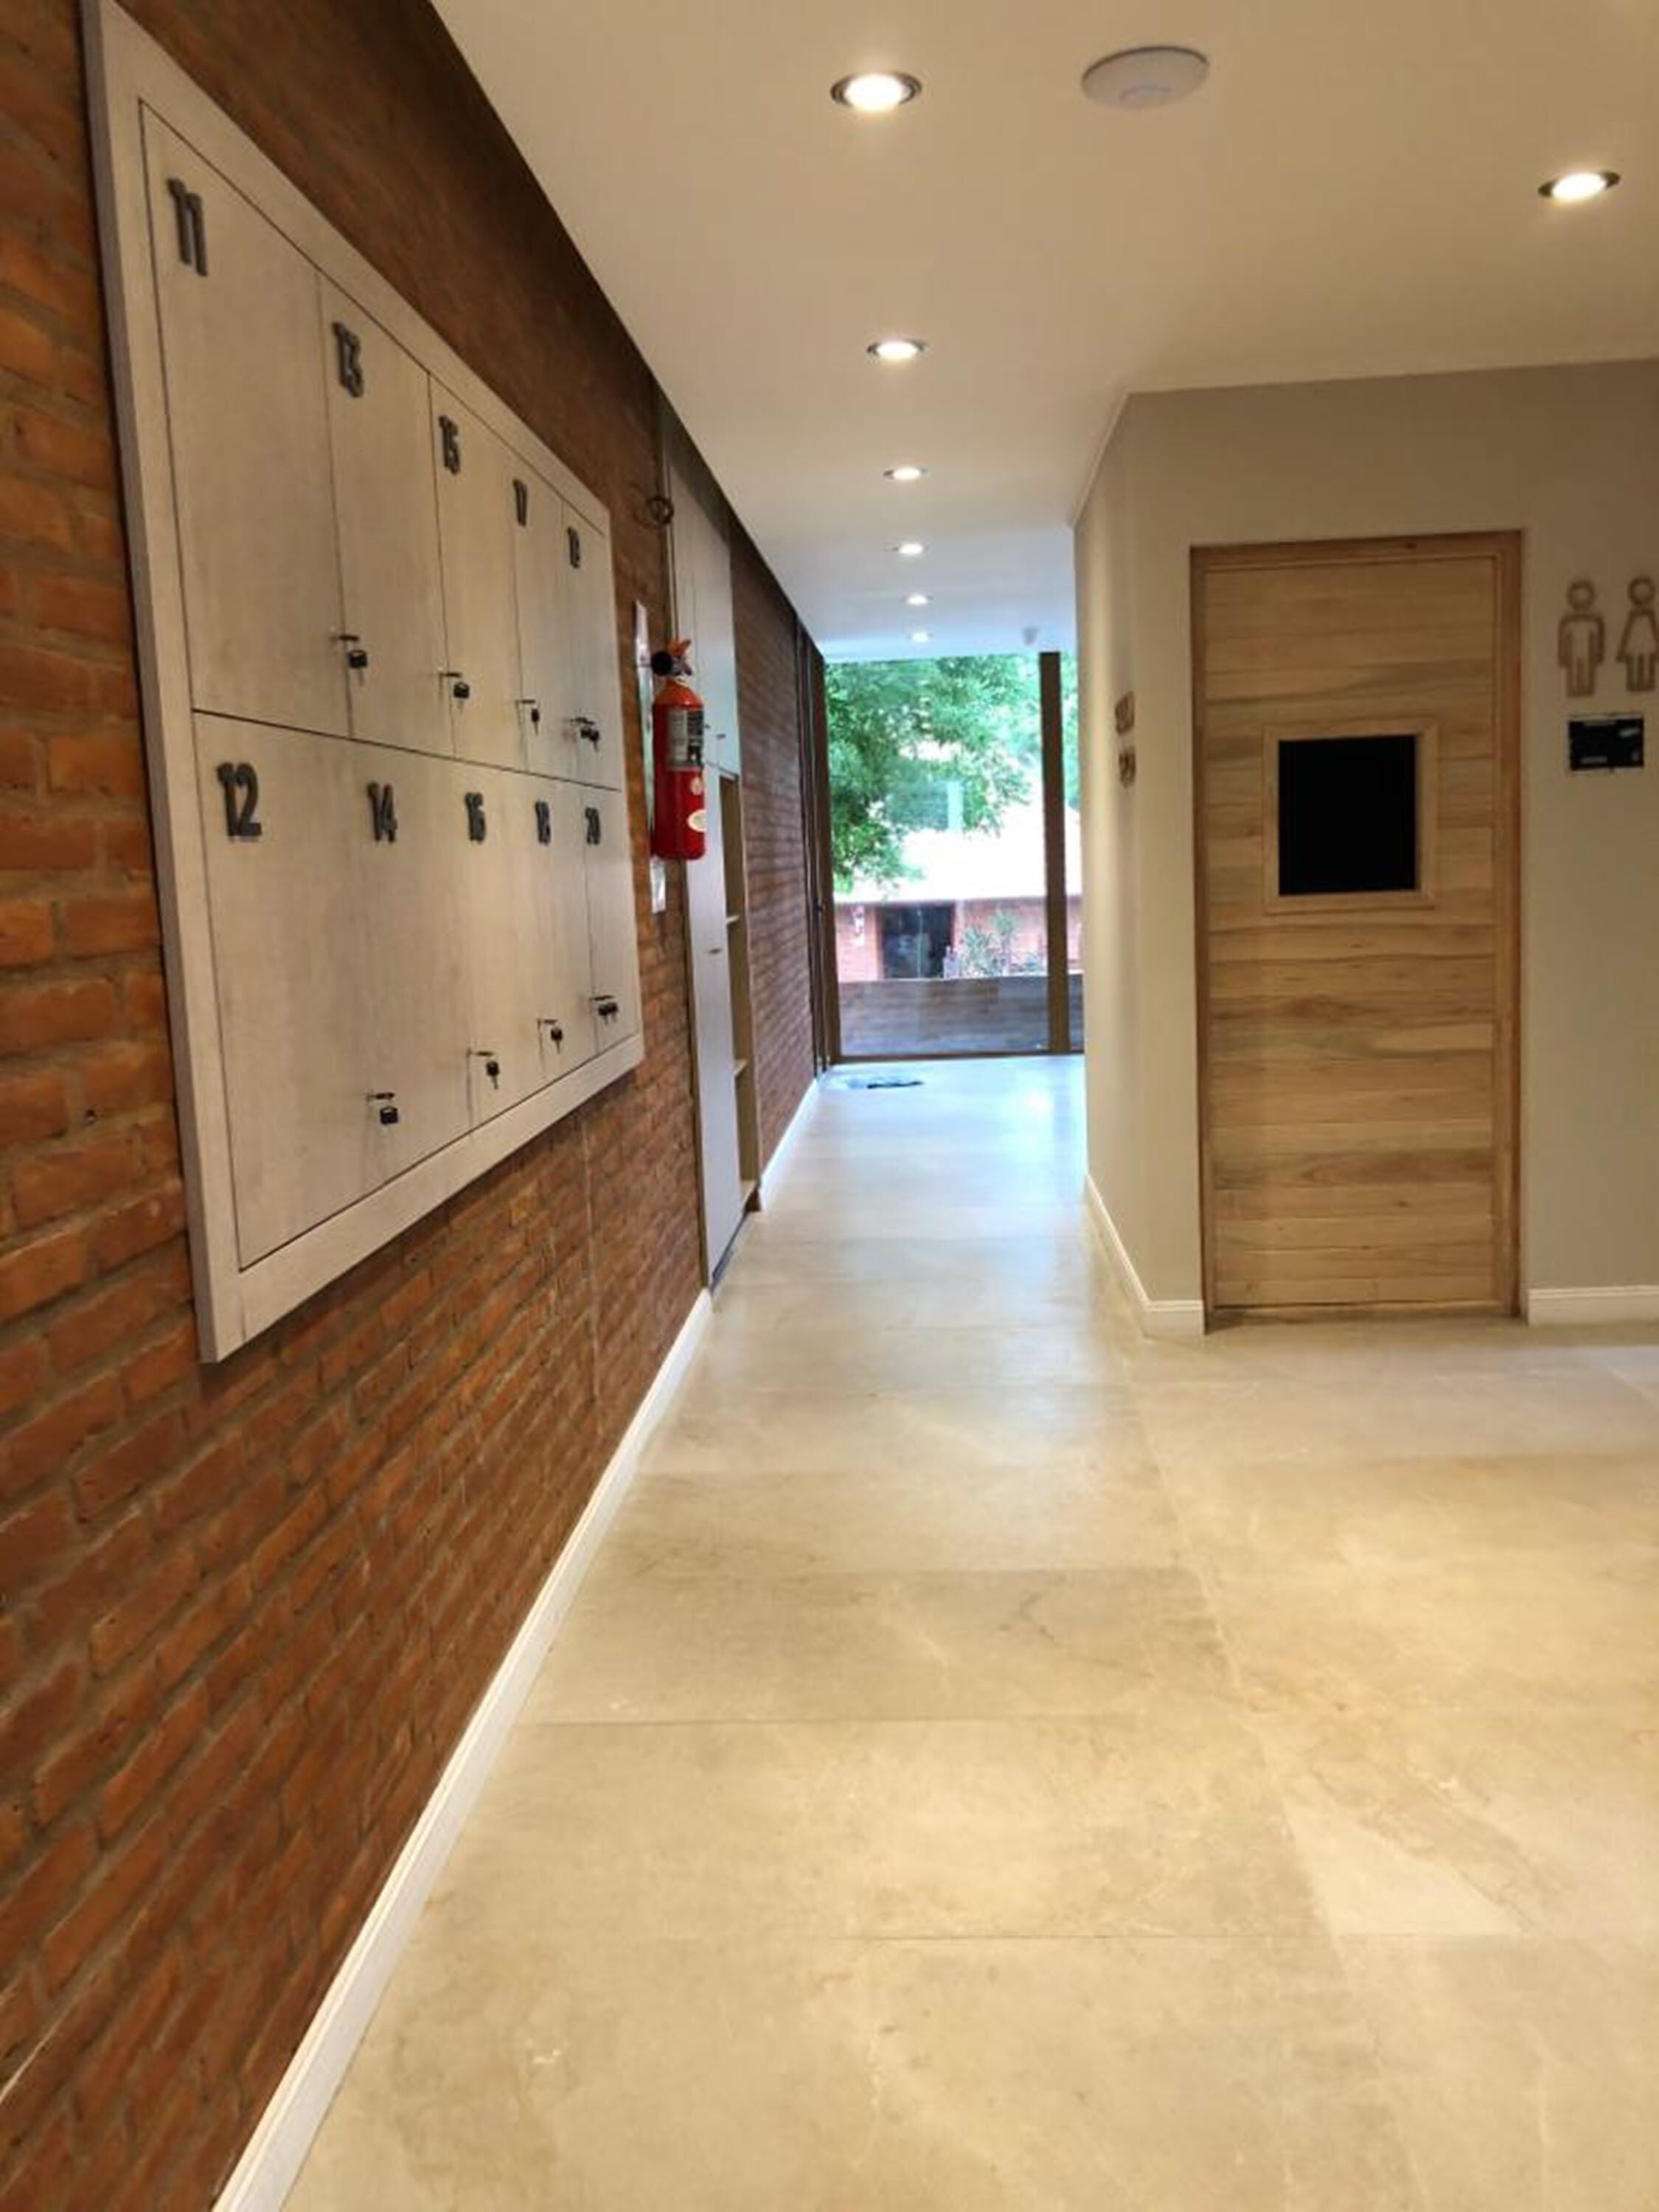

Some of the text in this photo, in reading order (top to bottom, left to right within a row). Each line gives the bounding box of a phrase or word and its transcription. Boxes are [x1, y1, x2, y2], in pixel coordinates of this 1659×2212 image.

[166, 178, 207, 276] 11
[332, 321, 364, 397] 13
[217, 762, 262, 837] 12
[366, 782, 397, 843] 14
